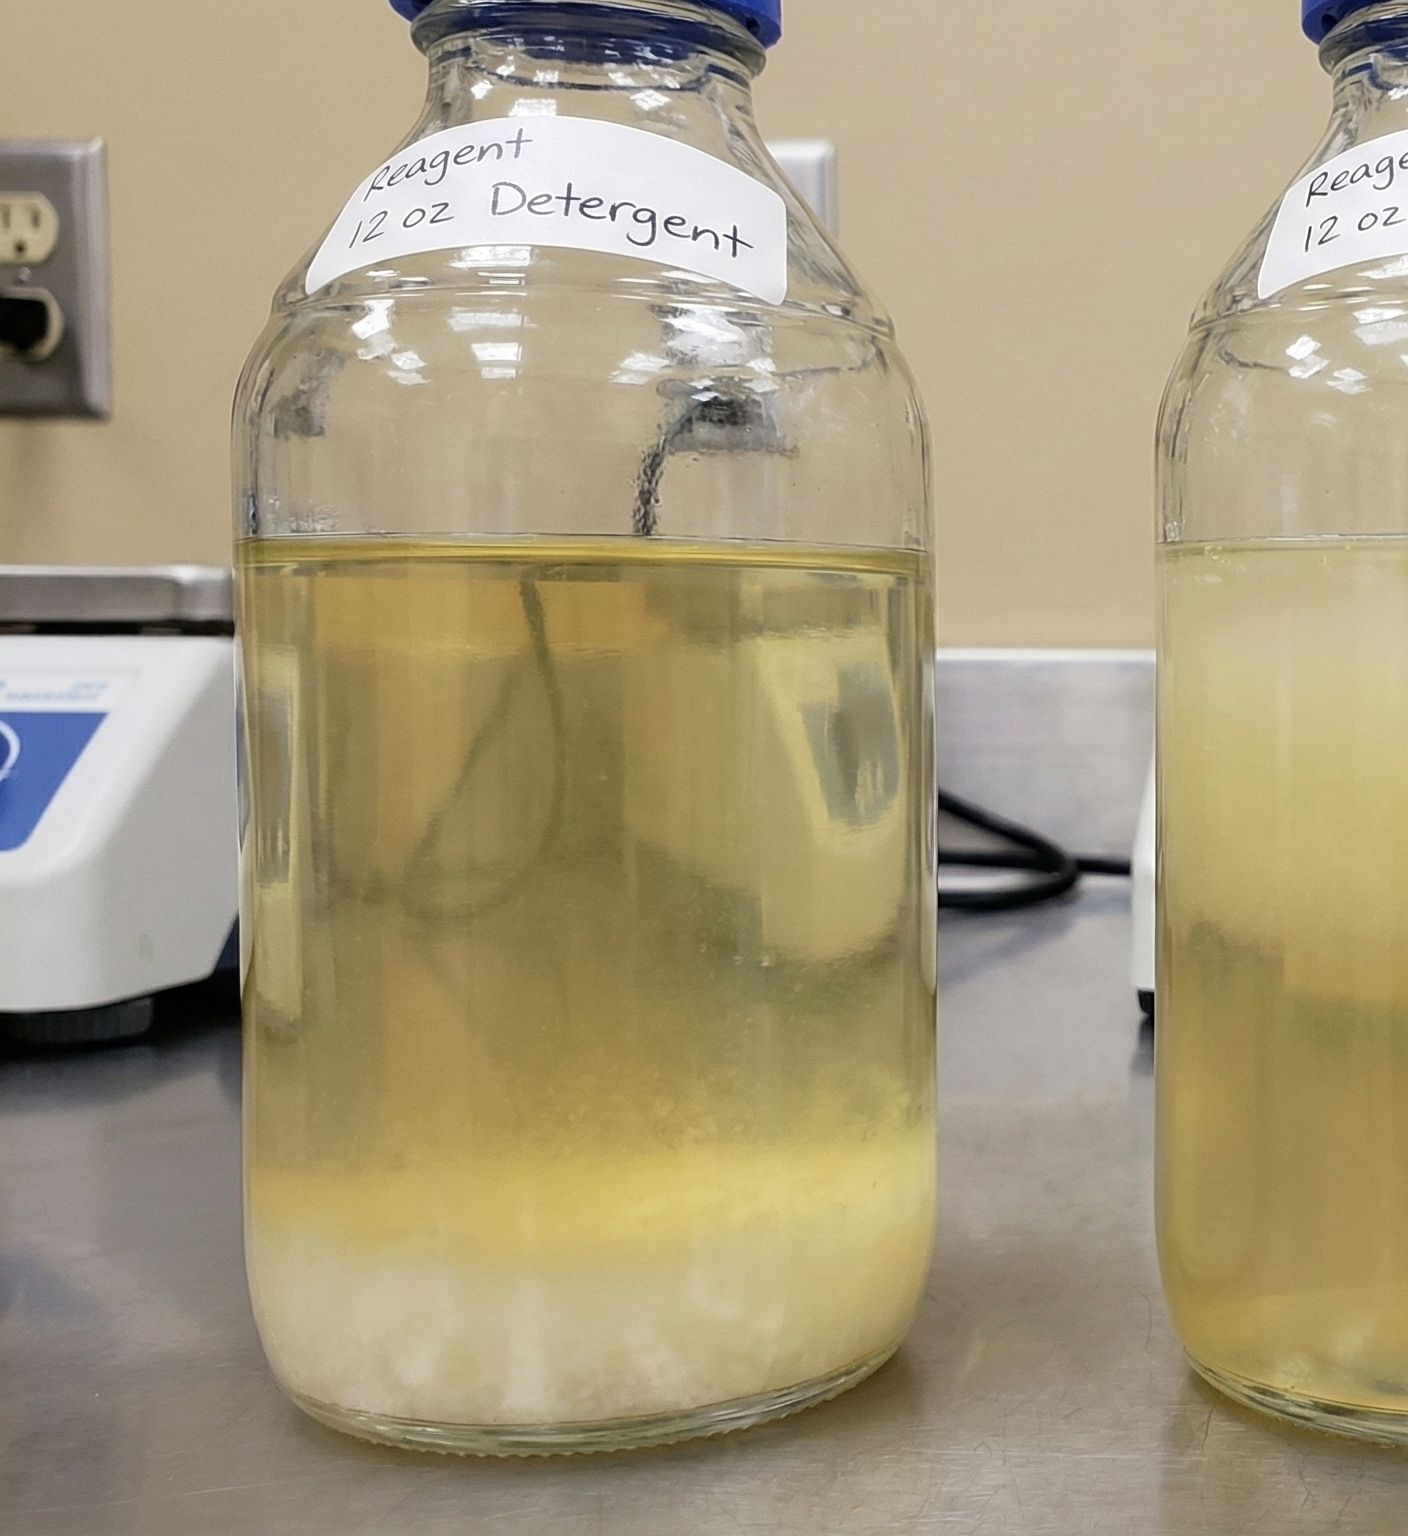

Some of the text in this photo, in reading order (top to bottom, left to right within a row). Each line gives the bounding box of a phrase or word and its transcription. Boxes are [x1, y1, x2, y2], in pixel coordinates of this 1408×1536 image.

[363, 127, 534, 203] Reagent
[348, 181, 755, 259] 12 oz Detergent
[1304, 215, 1341, 253] 12
[1356, 206, 1406, 232] oz
